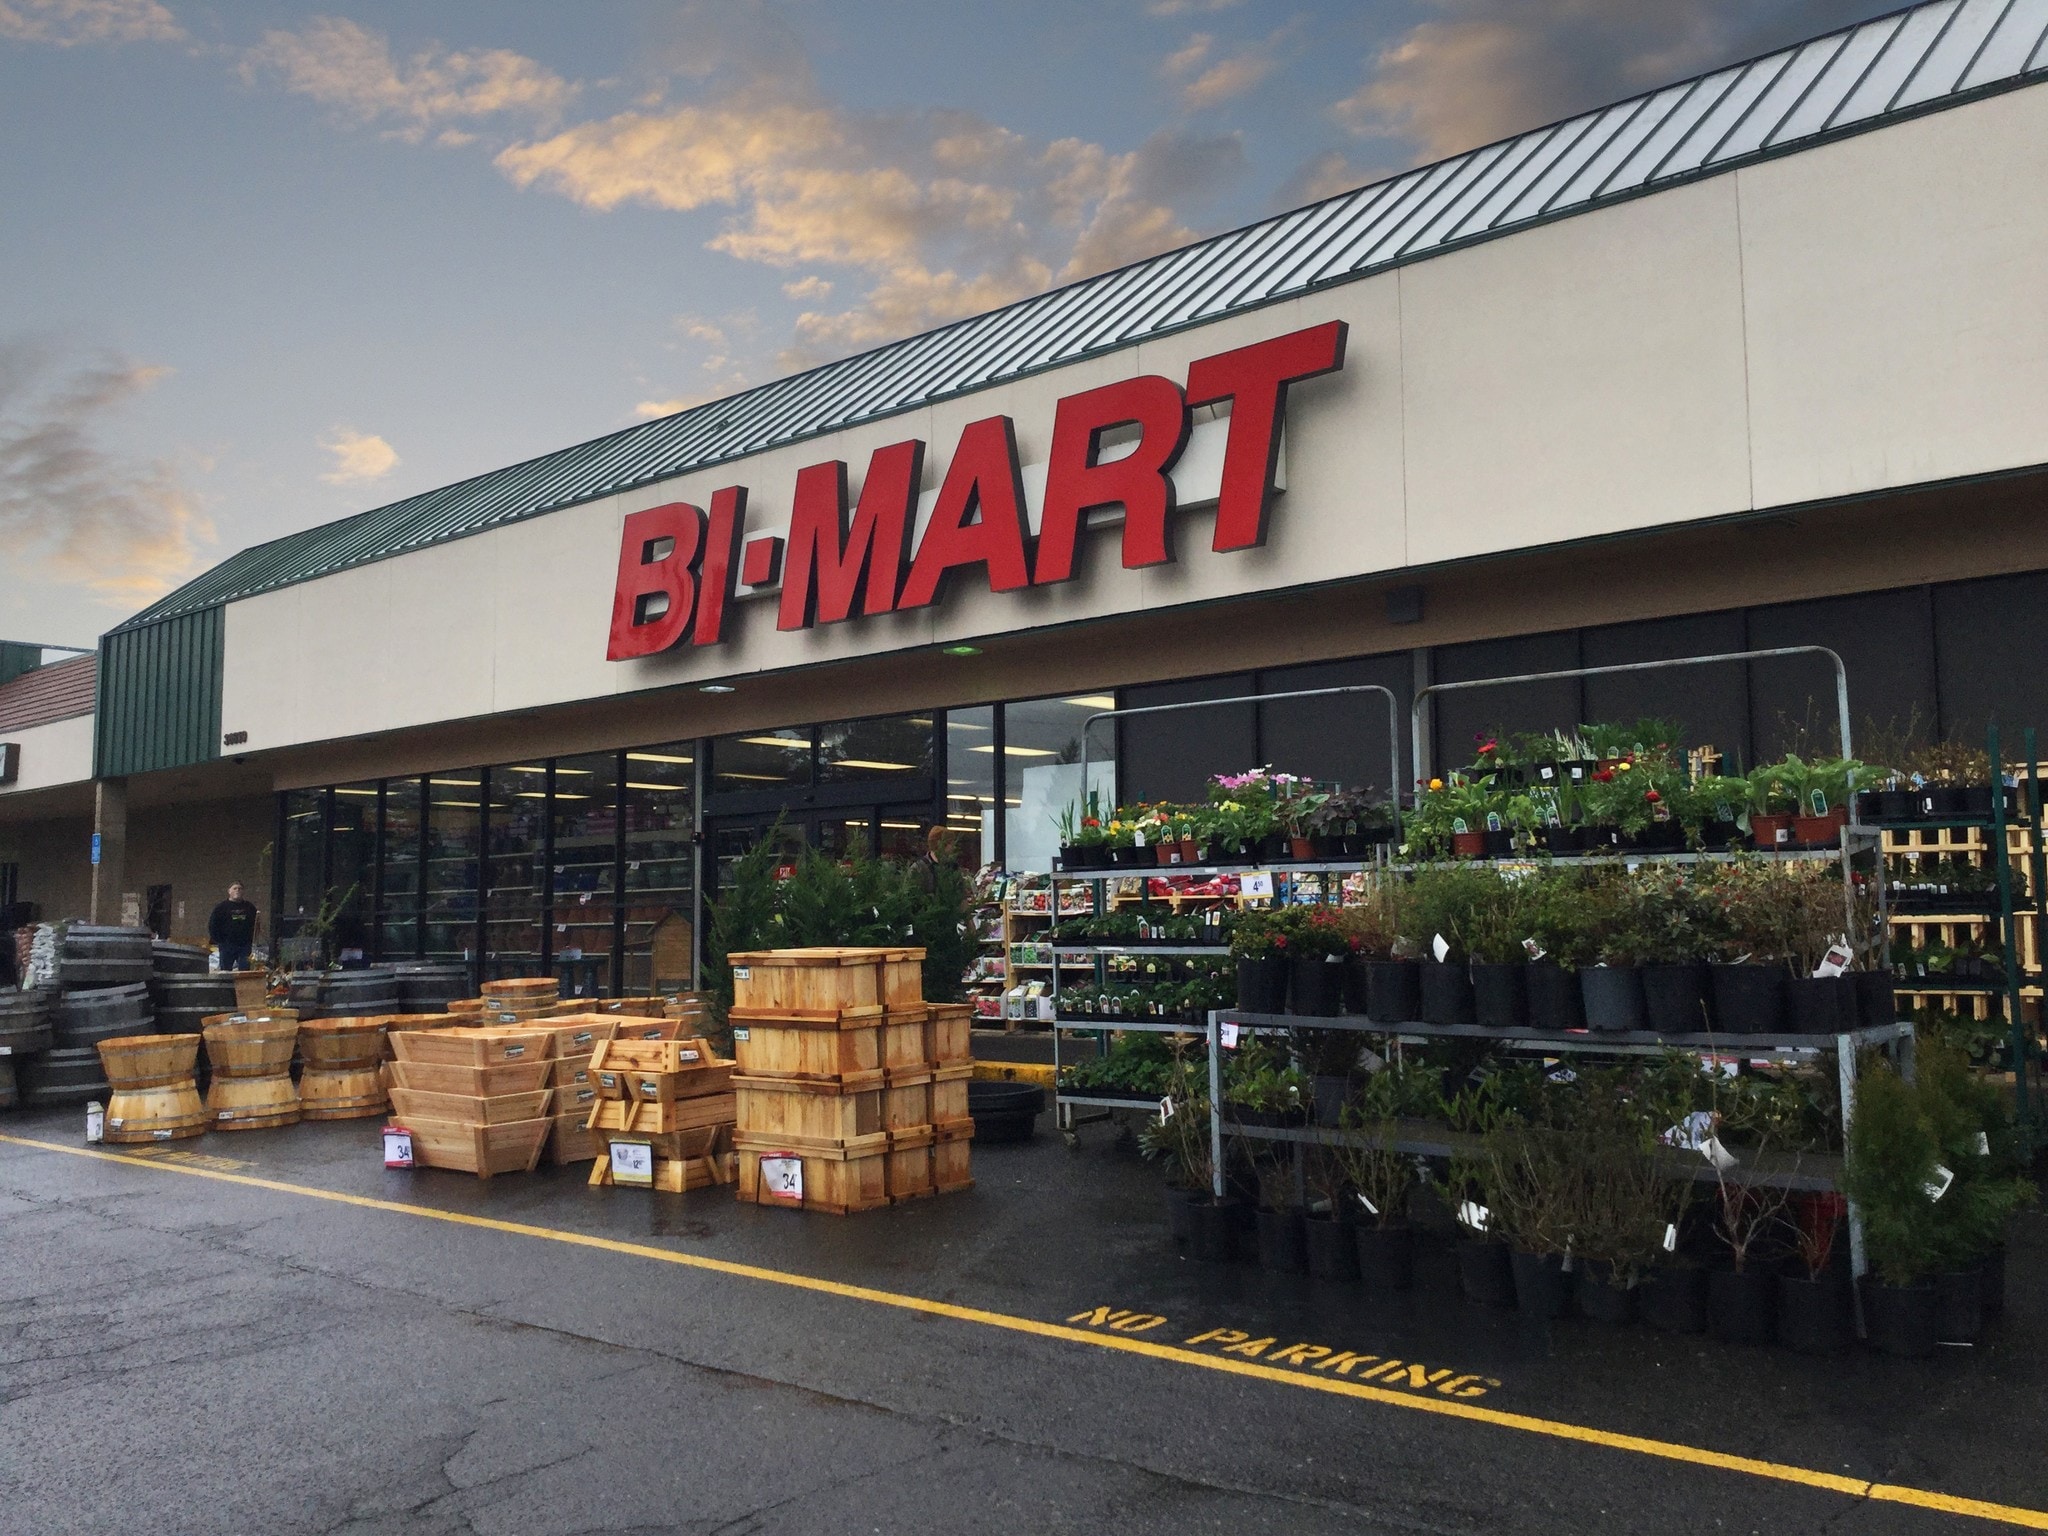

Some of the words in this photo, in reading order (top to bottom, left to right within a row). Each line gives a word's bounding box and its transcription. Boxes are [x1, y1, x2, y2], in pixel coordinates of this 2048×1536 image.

[606, 318, 1349, 662] BI-MART
[1066, 1305, 1168, 1332] NO
[1186, 1327, 1502, 1397] PARKING
